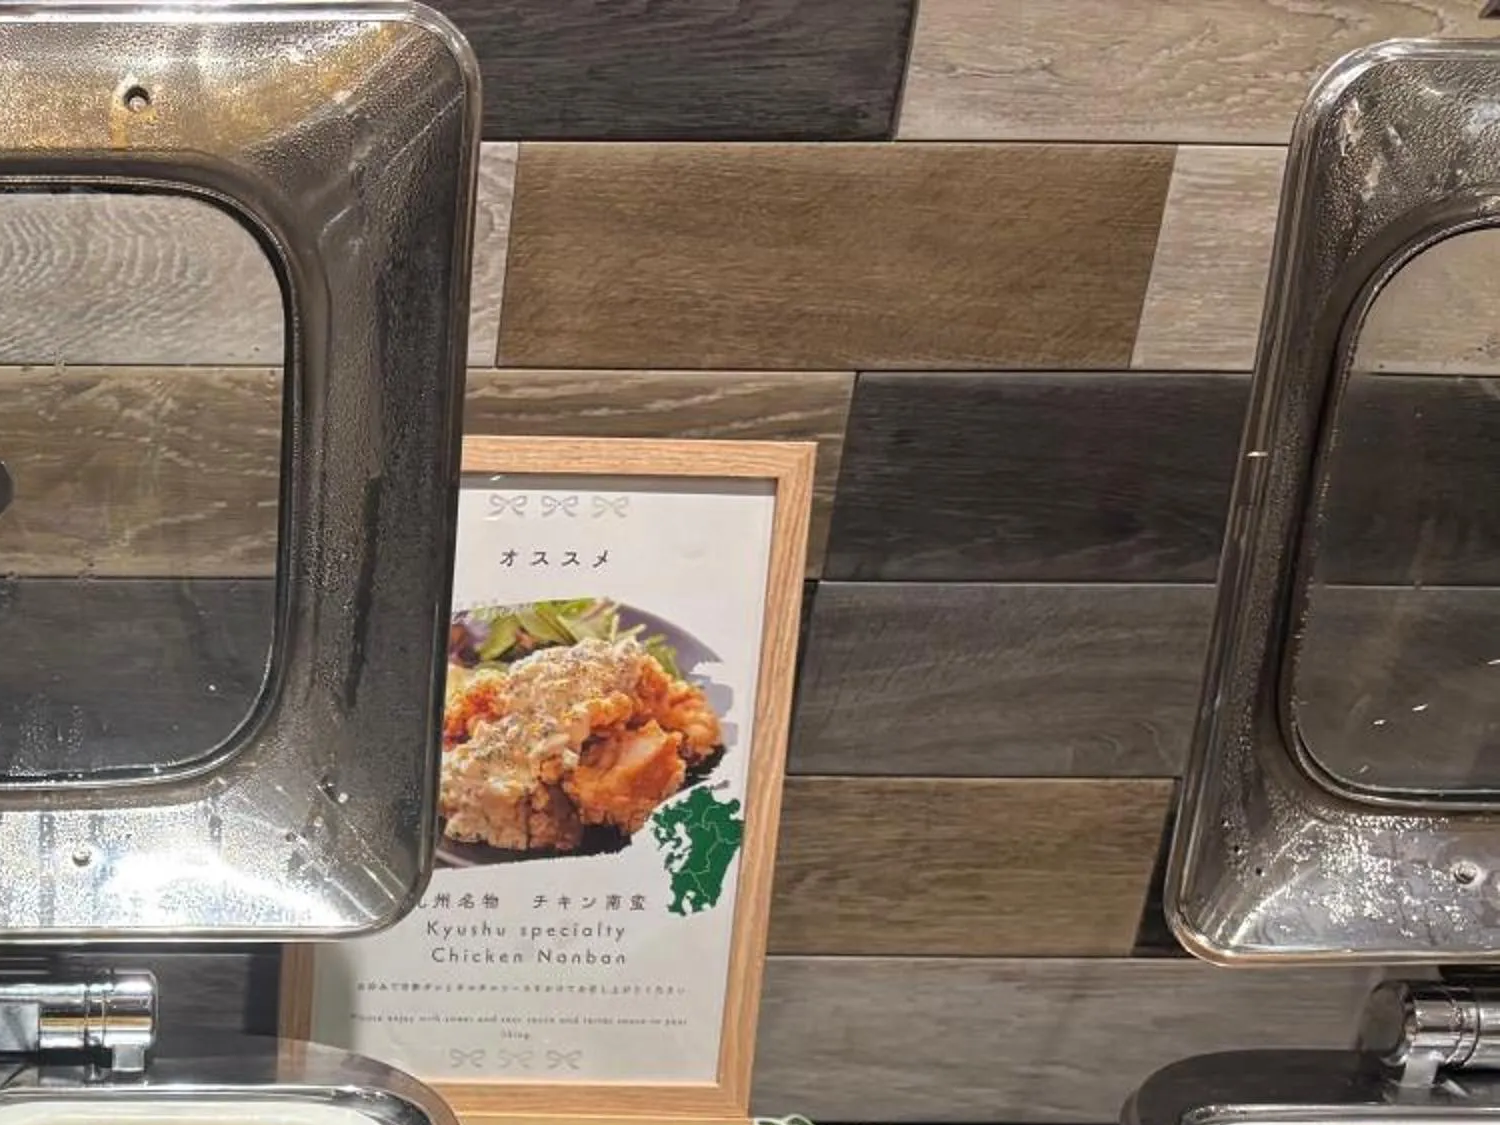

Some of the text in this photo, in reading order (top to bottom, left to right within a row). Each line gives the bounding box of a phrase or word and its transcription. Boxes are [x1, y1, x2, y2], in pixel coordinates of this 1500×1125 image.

[499, 549, 609, 569] オススメ
[426, 920, 627, 942] Kyushu specialty
[431, 946, 628, 966] Chicken Nanban
